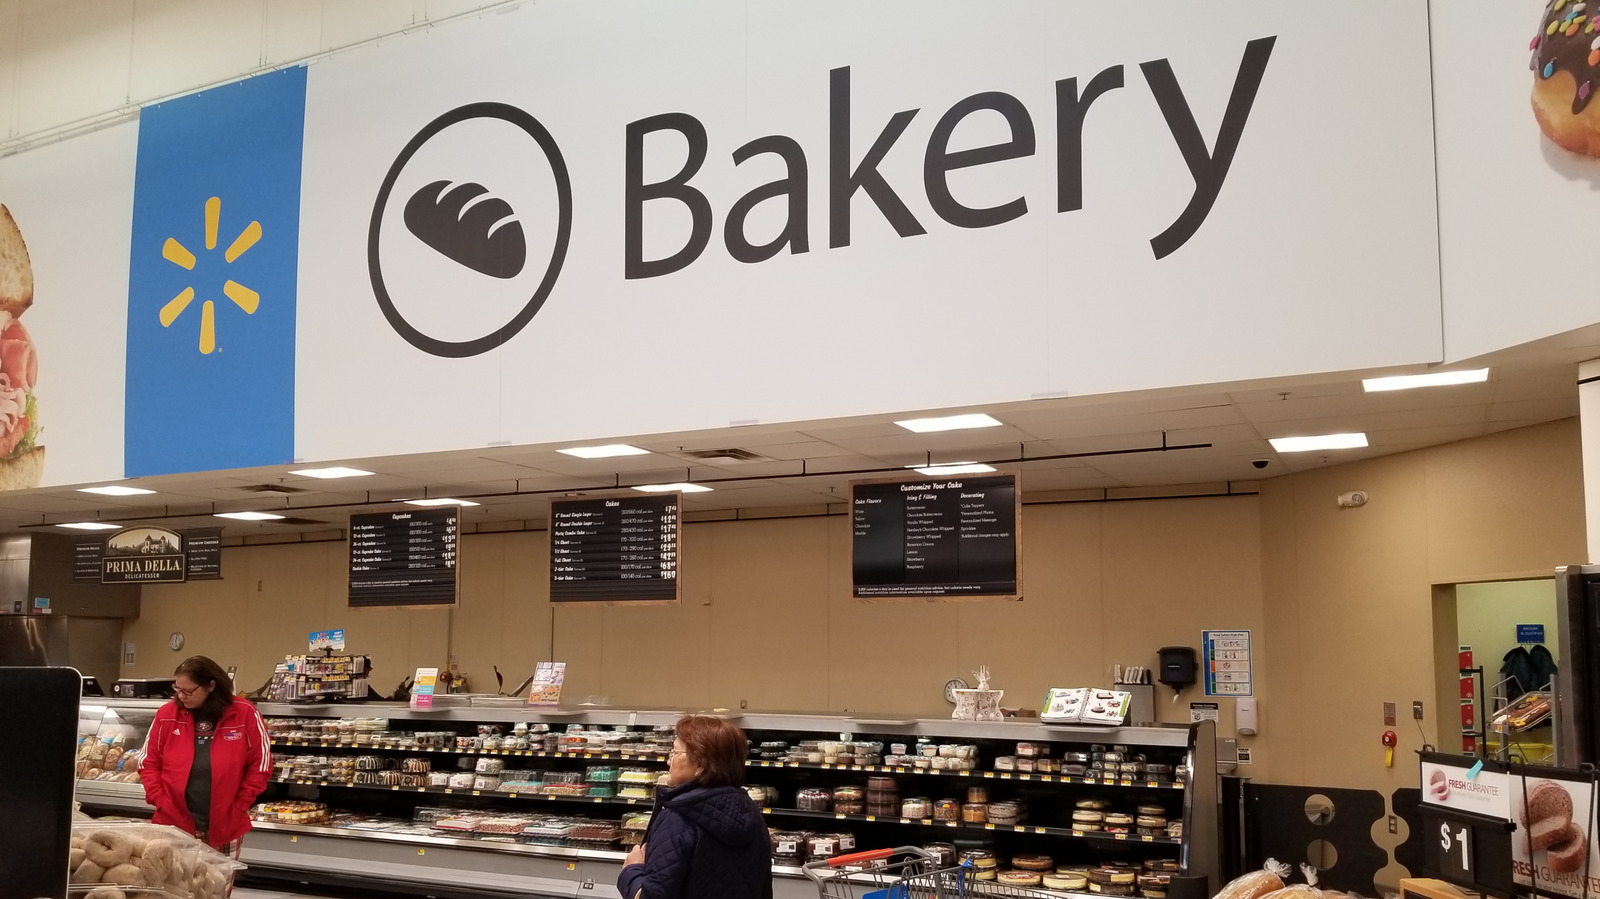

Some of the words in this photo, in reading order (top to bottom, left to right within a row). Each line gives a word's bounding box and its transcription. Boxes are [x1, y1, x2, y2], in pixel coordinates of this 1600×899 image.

[625, 35, 1277, 280] Bakery
[901, 483, 931, 491] Customize
[106, 560, 141, 573] PRIMA
[145, 559, 180, 571] DELLA
[661, 571, 676, 579] $160
[1449, 779, 1466, 790] FRESH
[1467, 782, 1499, 796] GUARANTEE
[1441, 821, 1469, 871] $1
[1513, 860, 1540, 879] RESH
